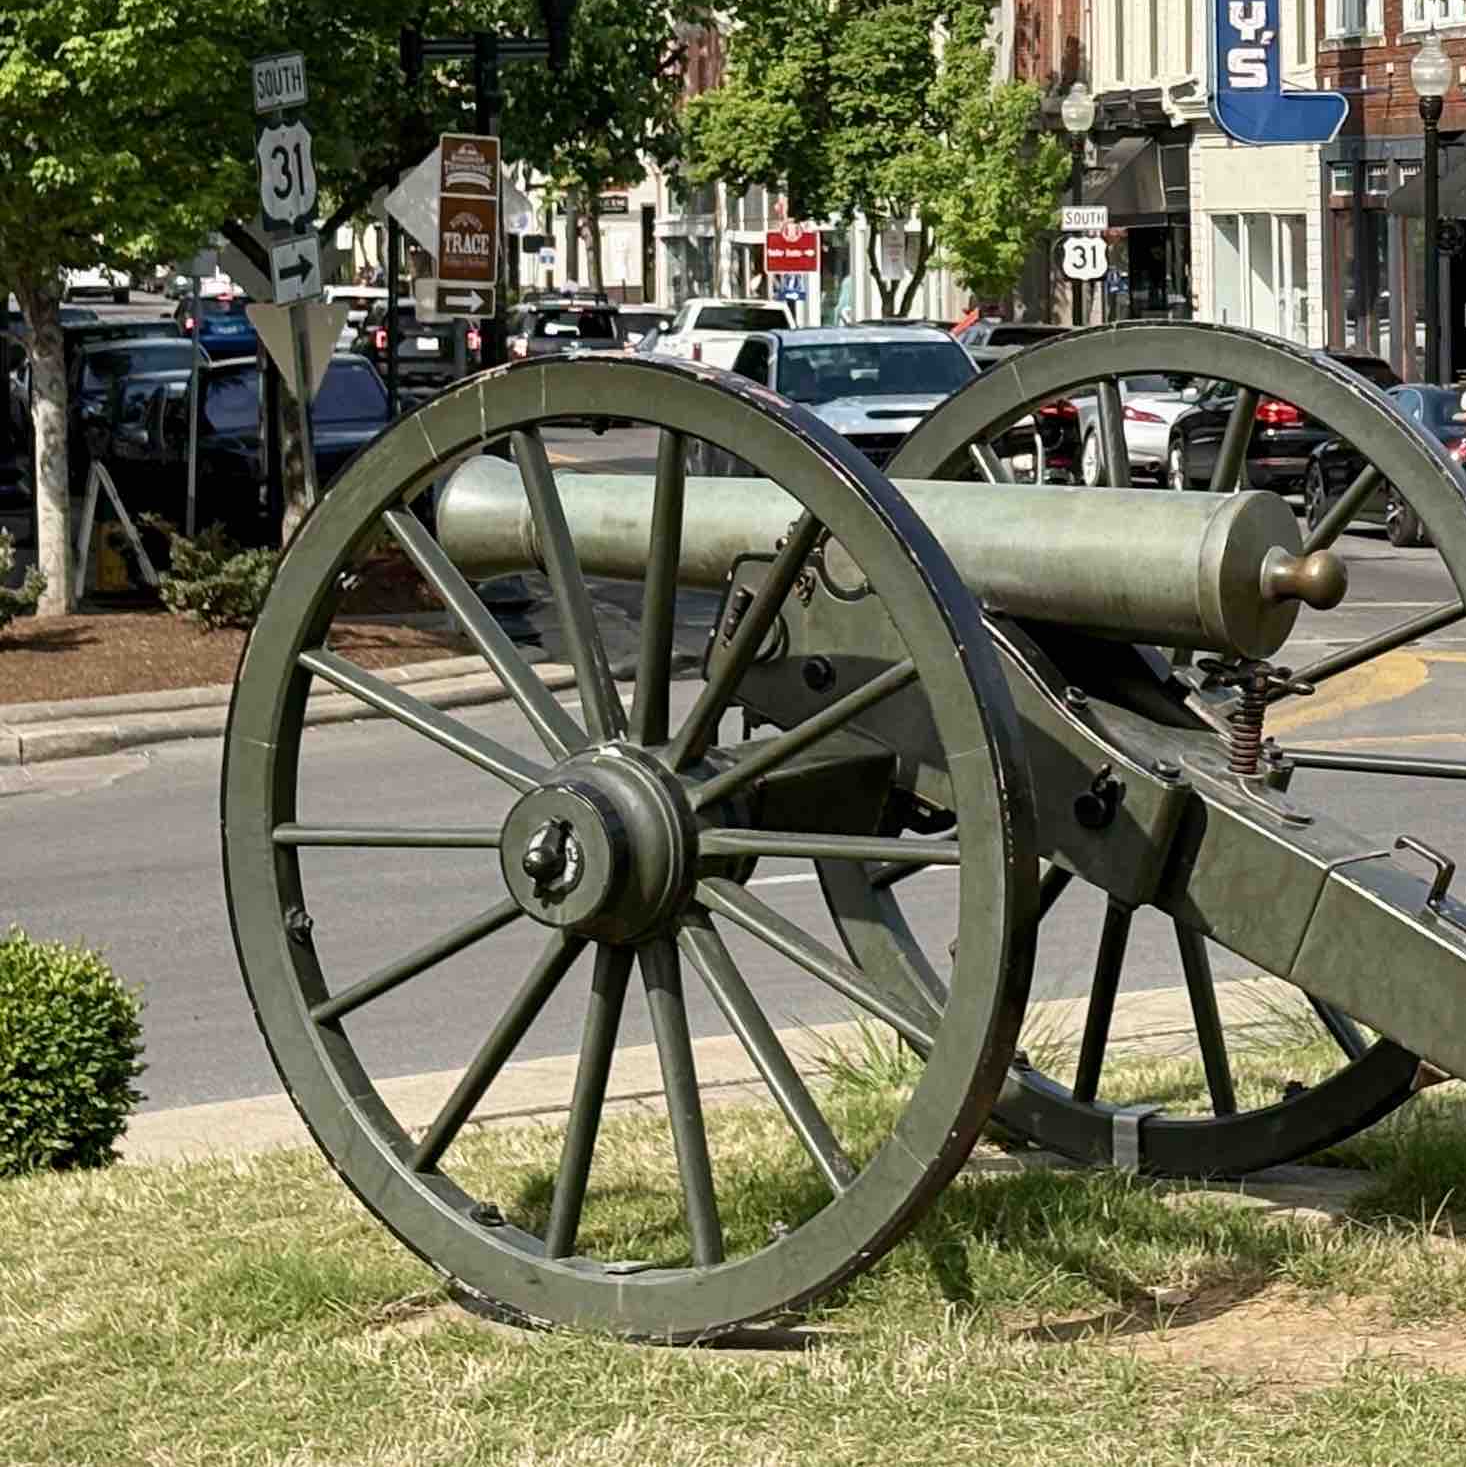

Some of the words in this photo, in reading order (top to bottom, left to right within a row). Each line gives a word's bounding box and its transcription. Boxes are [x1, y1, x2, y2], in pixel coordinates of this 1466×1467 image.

[257, 66, 301, 99] SOUTH
[271, 142, 305, 200] 31
[1065, 212, 1106, 224] SOUTH
[443, 233, 490, 254] TRACE
[1072, 245, 1097, 269] 31
